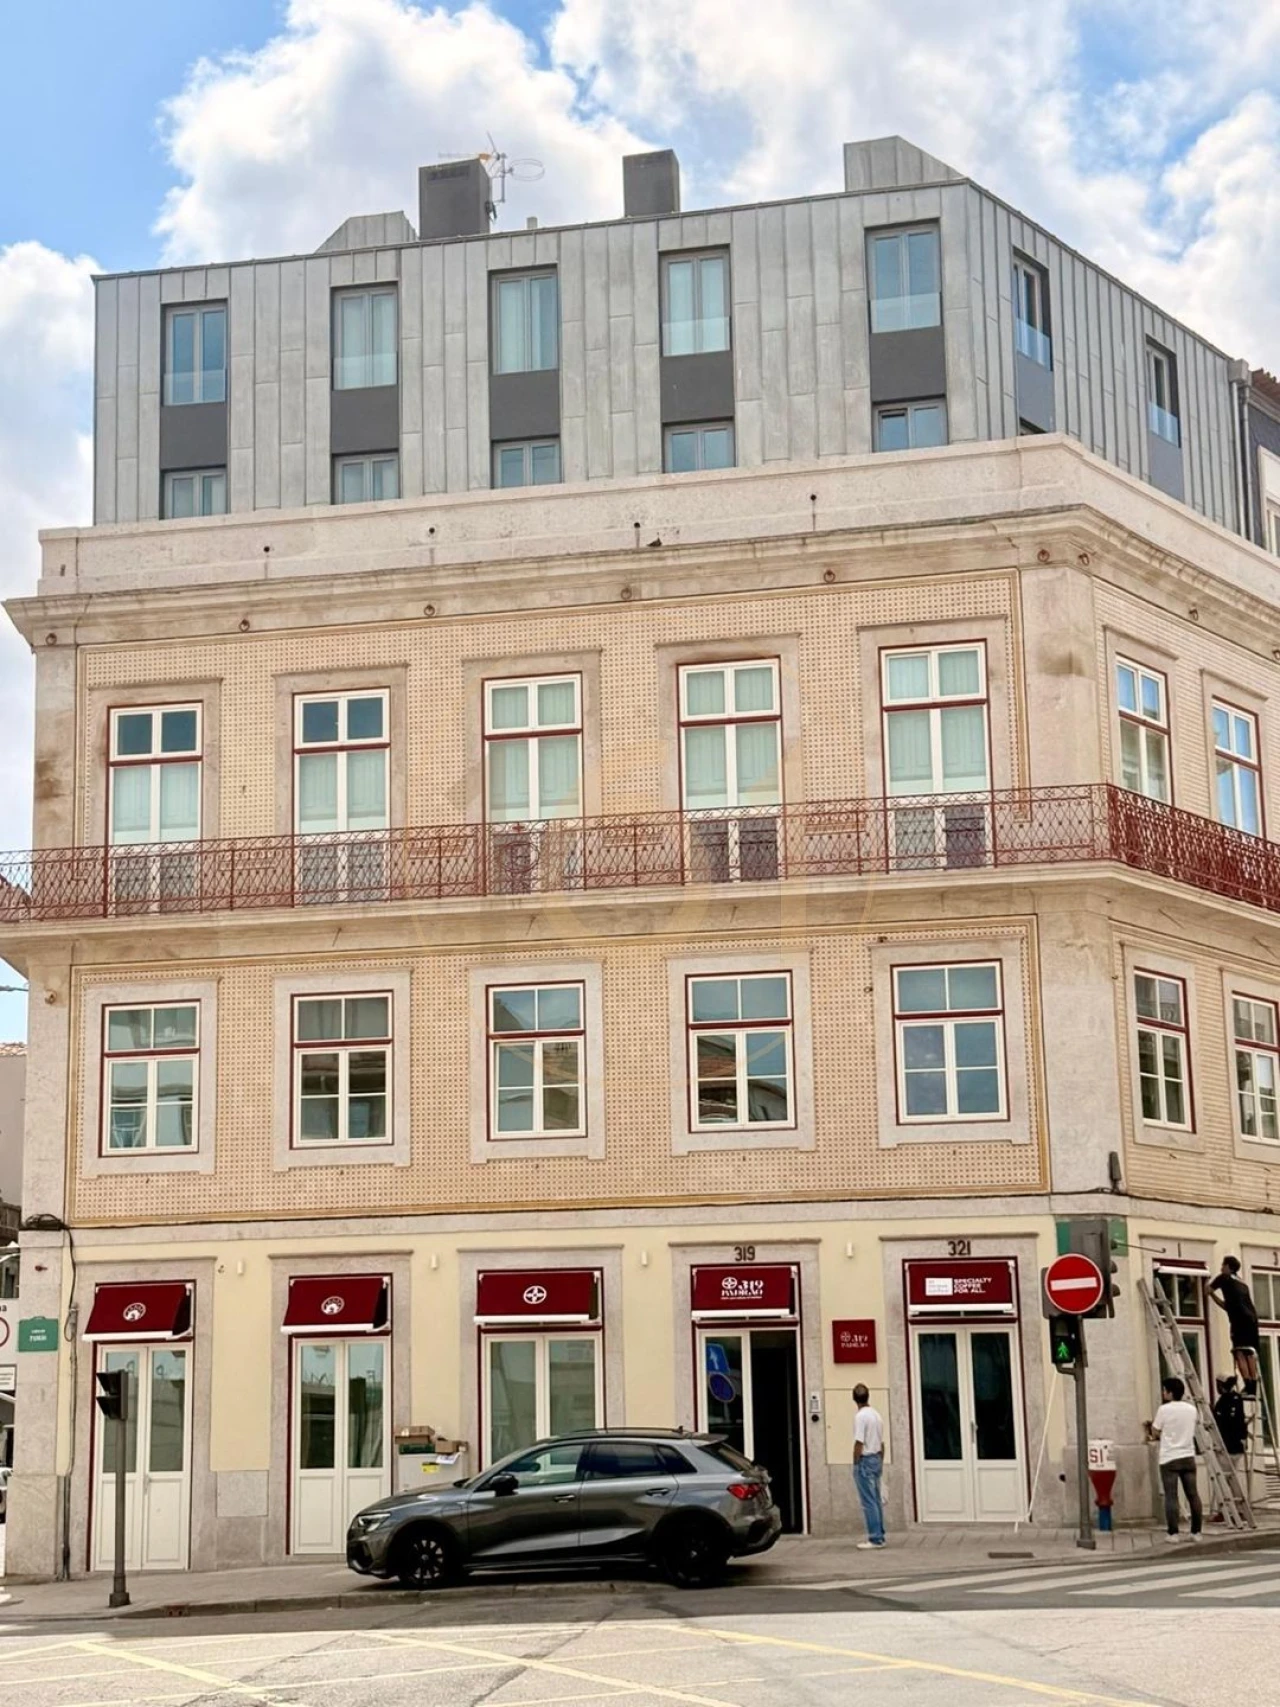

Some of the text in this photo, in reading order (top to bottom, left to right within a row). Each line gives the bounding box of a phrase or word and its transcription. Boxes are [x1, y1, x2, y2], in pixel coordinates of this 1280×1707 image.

[734, 1245, 756, 1262] 319
[947, 1240, 972, 1257] 321
[953, 1277, 992, 1285] SPECIALTY
